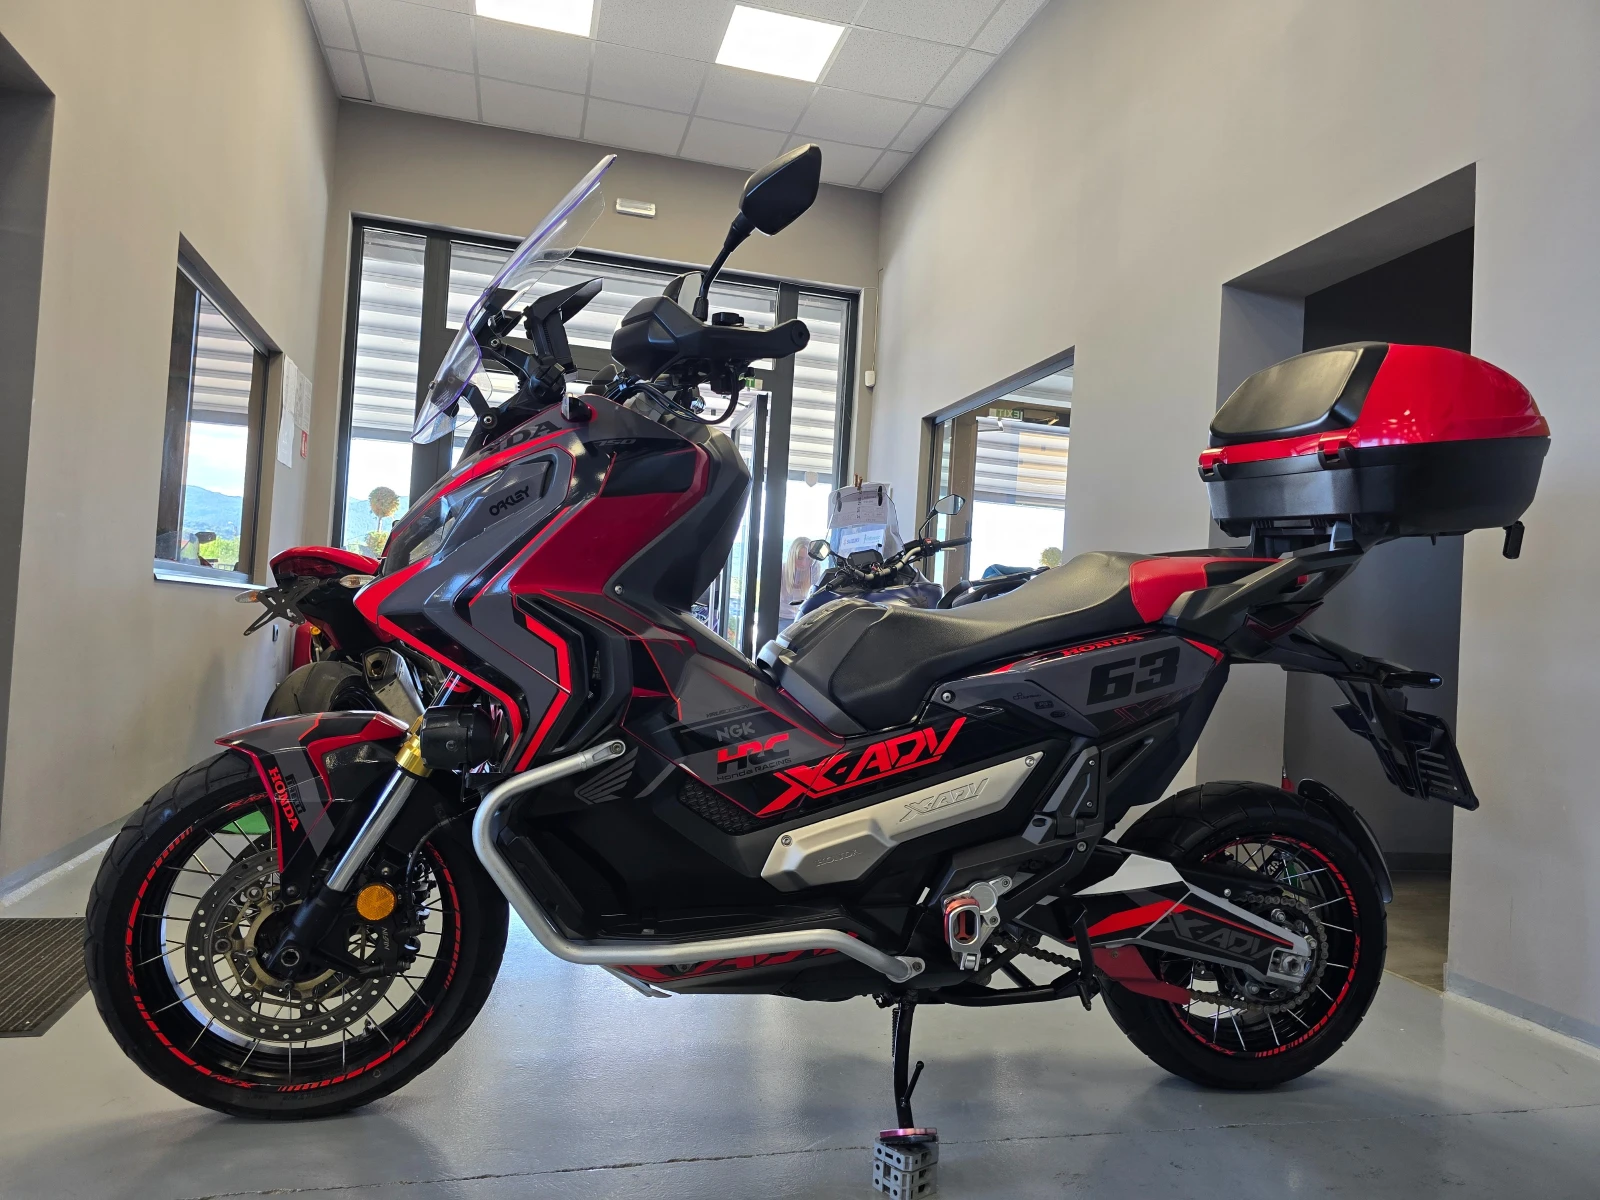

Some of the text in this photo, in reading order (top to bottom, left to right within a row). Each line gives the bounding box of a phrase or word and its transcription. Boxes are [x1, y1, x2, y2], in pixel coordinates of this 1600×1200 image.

[489, 486, 529, 516] OAKLEY
[1061, 634, 1144, 657] HONDA
[1086, 646, 1181, 706] 63
[716, 721, 756, 742] NGK
[717, 732, 790, 775] HRC
[716, 757, 792, 781] Honda RACING
[756, 716, 967, 816] X-ADV
[268, 767, 299, 831] HONDA
[899, 777, 989, 823] X-ADV
[1150, 911, 1281, 961] X-ADV
